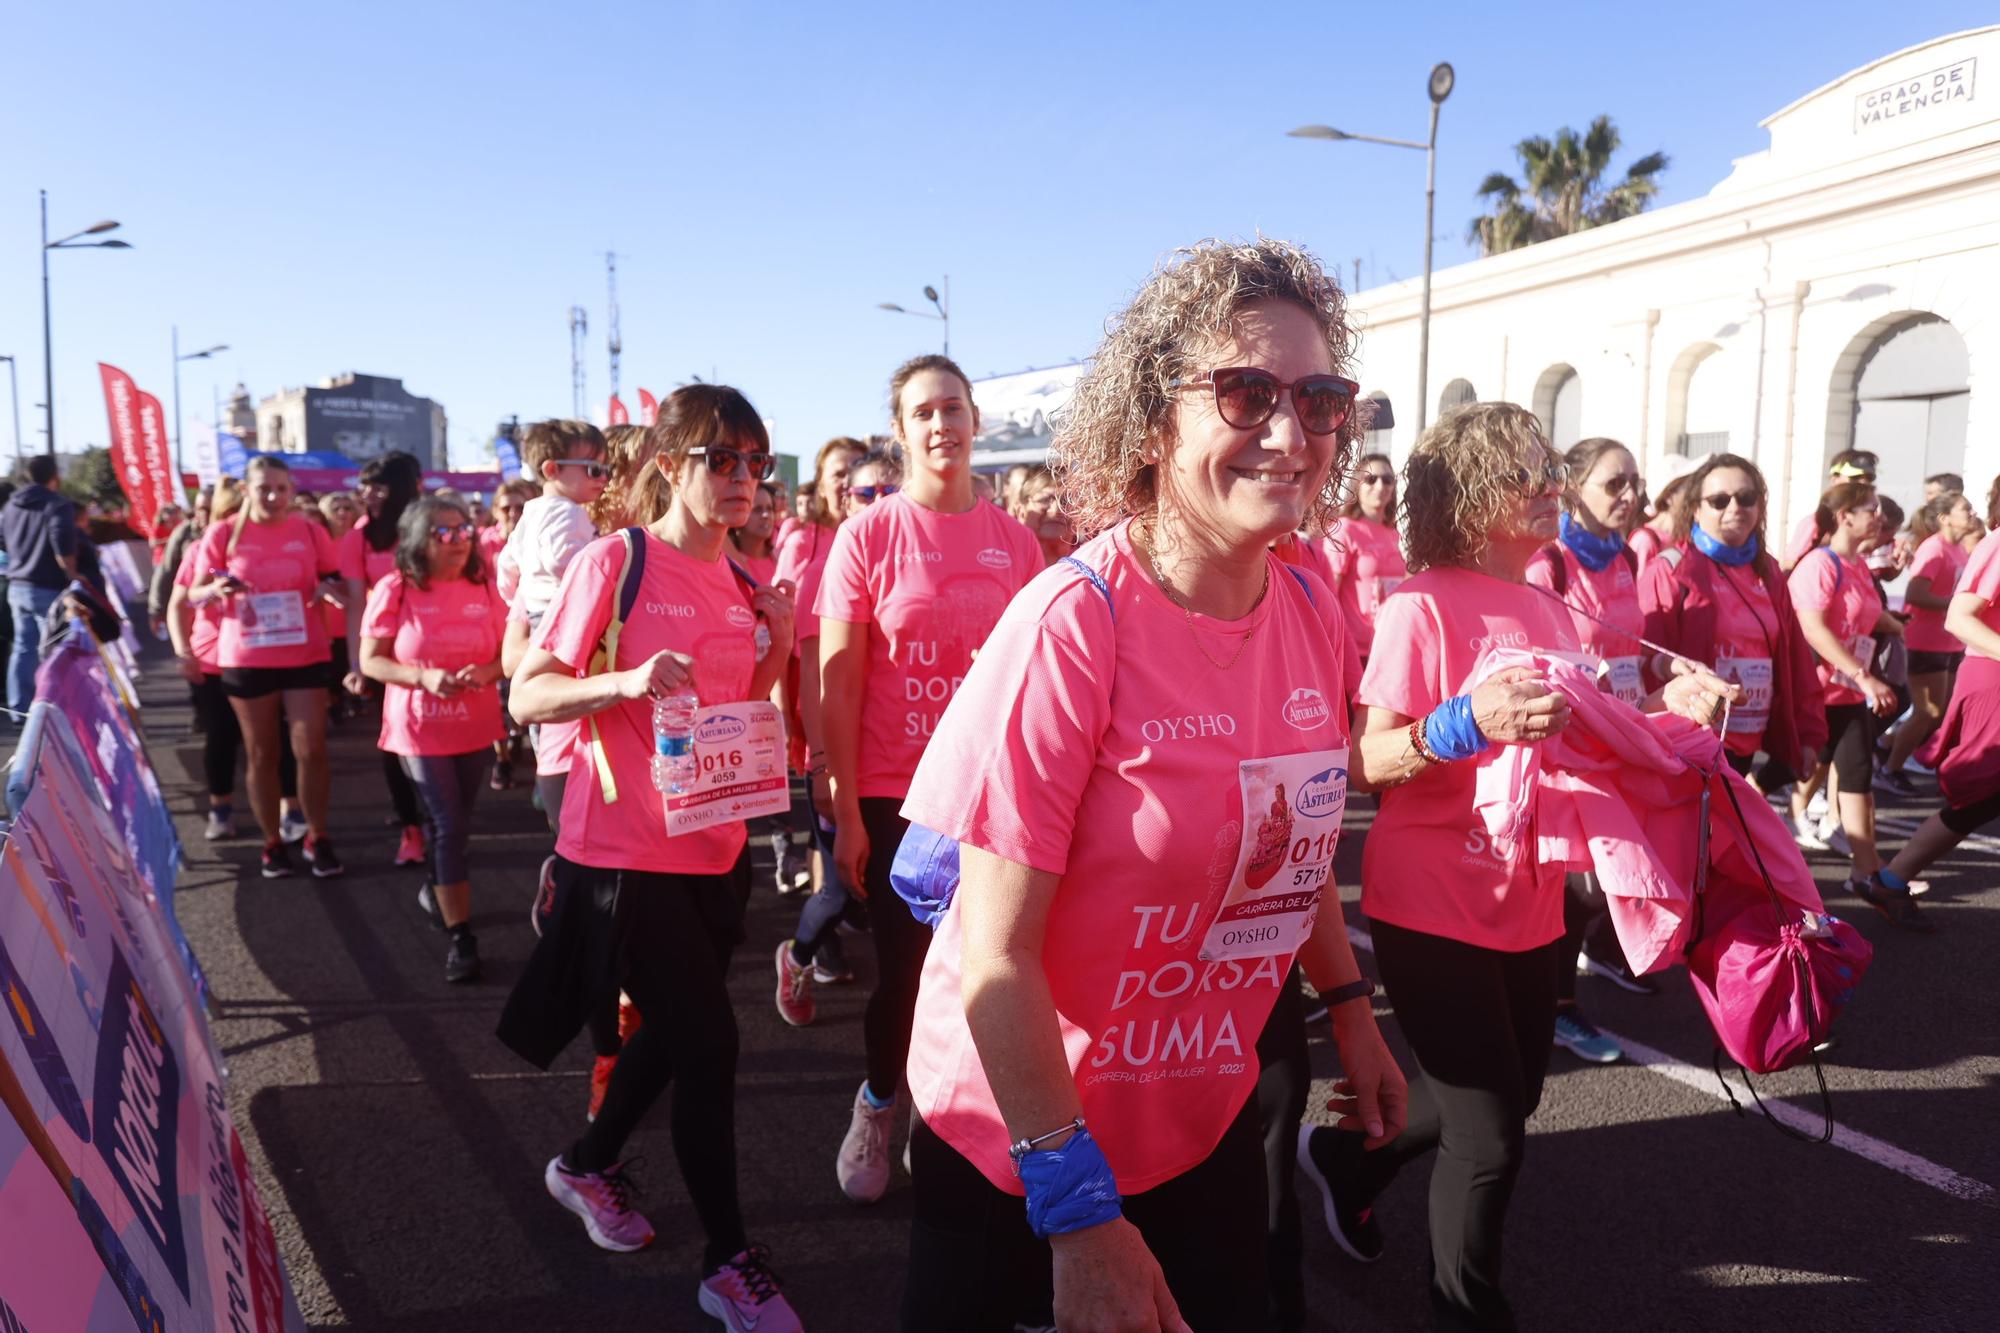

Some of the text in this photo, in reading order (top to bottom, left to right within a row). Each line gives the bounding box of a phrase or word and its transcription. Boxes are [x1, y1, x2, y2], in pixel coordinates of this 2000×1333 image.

[1866, 67, 1963, 108] GRAO DE
[1861, 84, 1965, 125] VALENCIA
[894, 551, 943, 564] OYSHO
[646, 602, 696, 617] OYSHO
[1469, 631, 1529, 651] OYSHO
[905, 640, 937, 666] TU
[700, 725, 742, 739] ASTURIANA
[1141, 713, 1236, 742] OYSHO
[703, 750, 743, 771] 016
[711, 771, 736, 784] 4059
[712, 791, 721, 799] DE
[678, 809, 713, 825] OYSHO
[1291, 828, 1338, 863] 016
[1293, 865, 1327, 886] 5715
[1236, 899, 1283, 916] CARRERA
[1286, 897, 1301, 908] DE
[1132, 902, 1200, 949] TU
[1222, 926, 1279, 945] OYSHO
[1091, 1009, 1243, 1068] SUMA
[1085, 1063, 1246, 1087] CARRERA DE LA MUJER 2023
